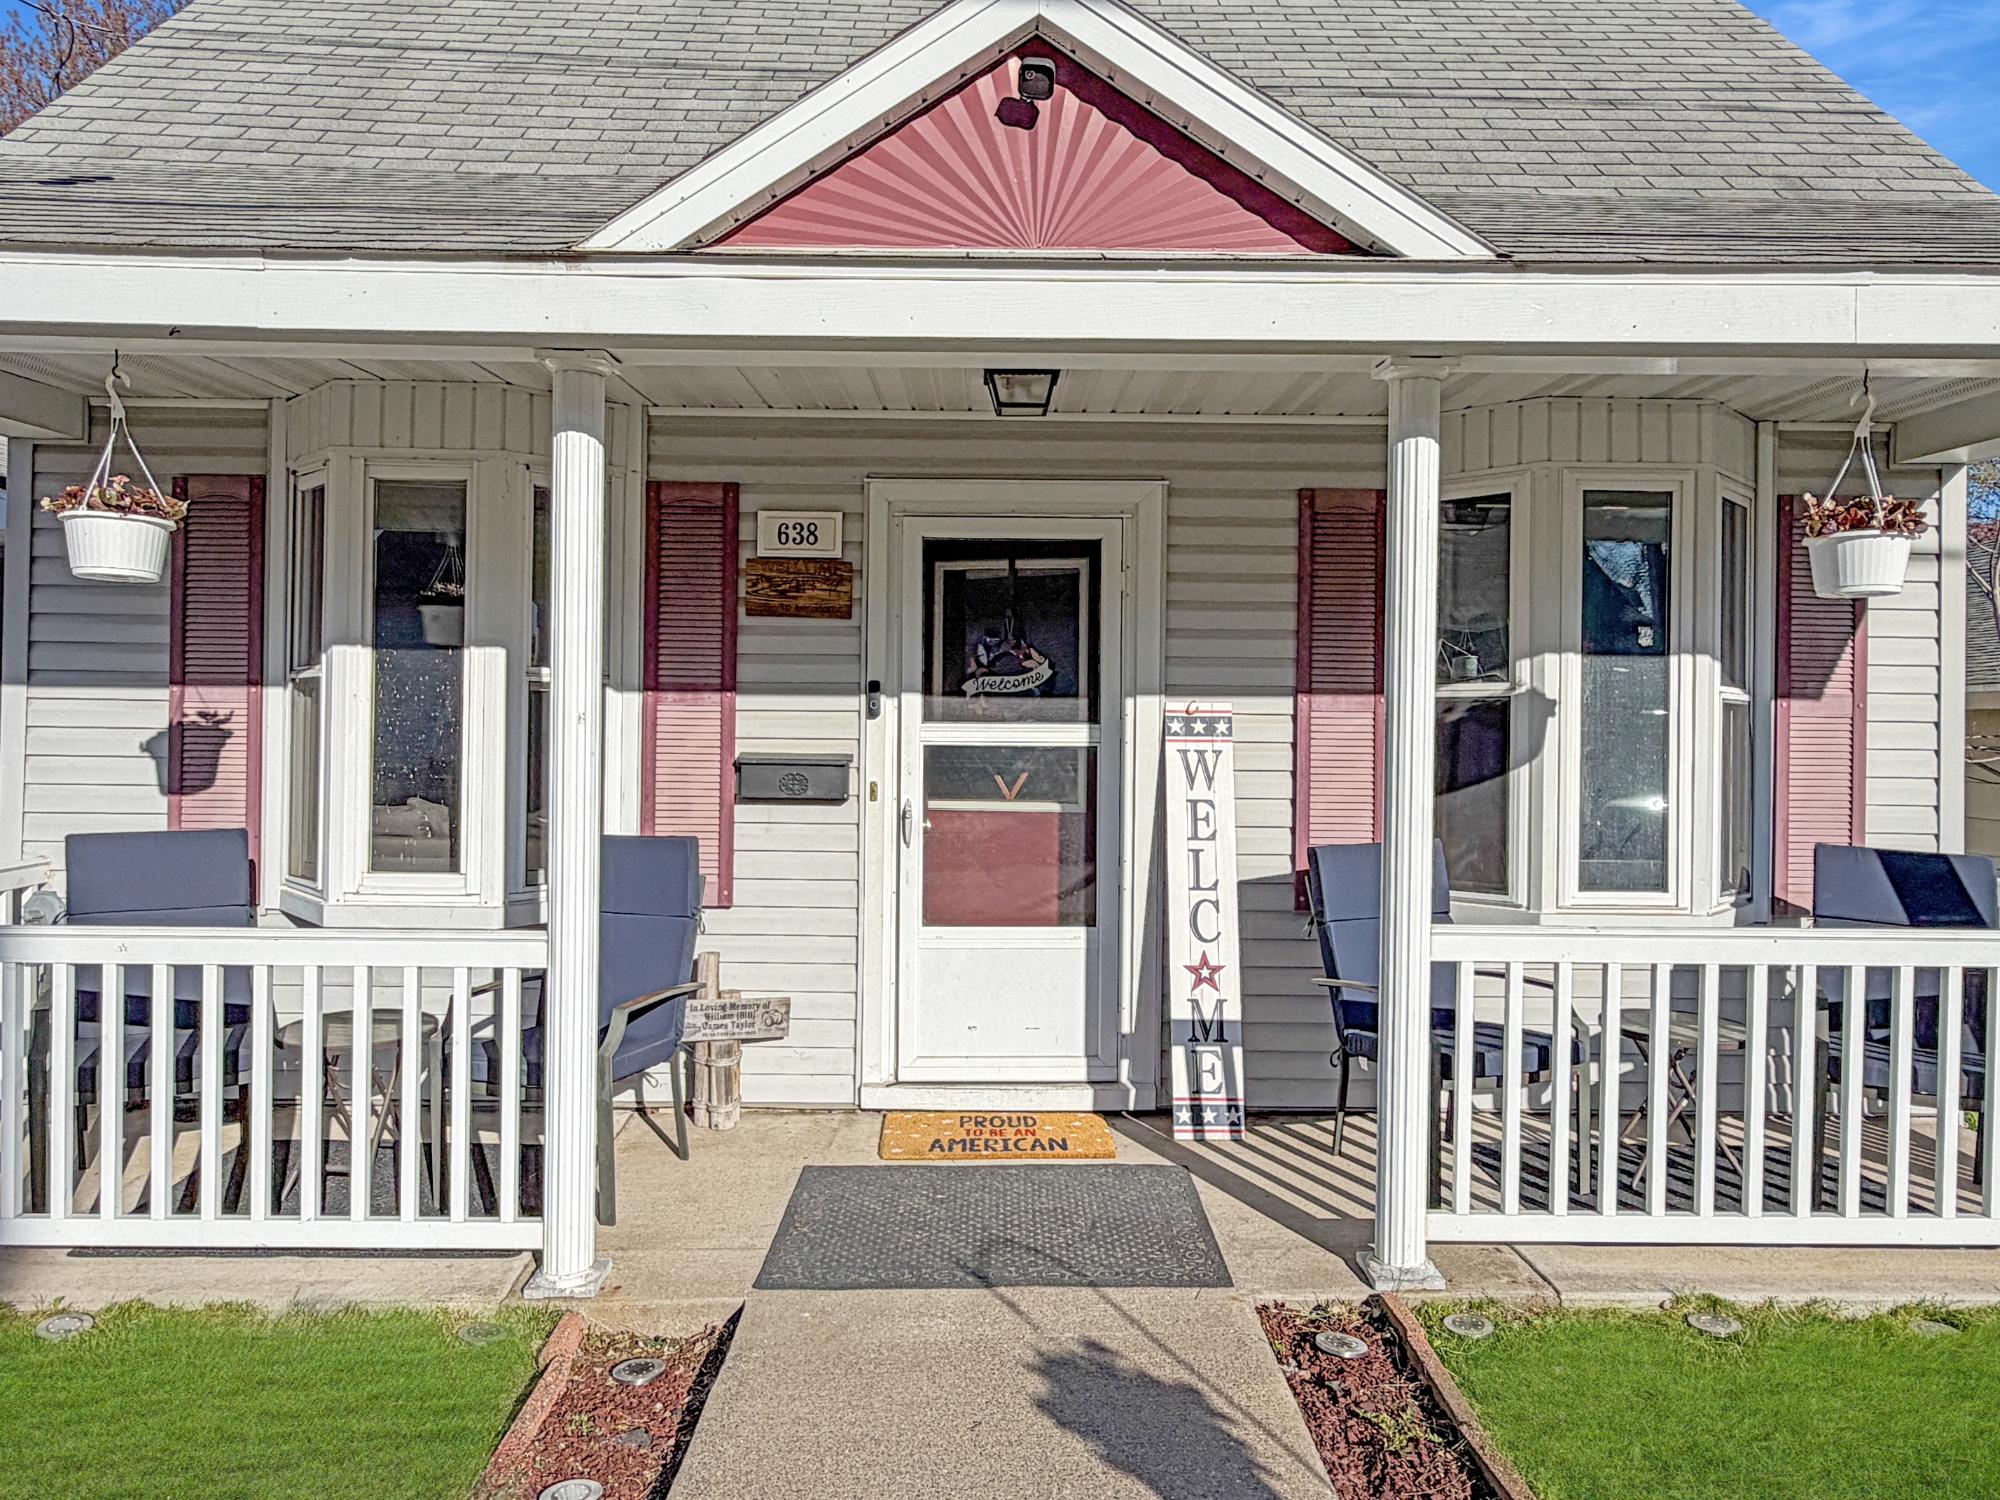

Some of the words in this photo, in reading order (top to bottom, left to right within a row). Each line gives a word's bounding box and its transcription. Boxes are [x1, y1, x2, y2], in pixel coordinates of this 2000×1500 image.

[777, 522, 819, 546] 638
[973, 671, 1044, 691] Welcome
[1177, 749, 1228, 1095] WELCME
[689, 1004, 698, 1012] In
[700, 1003, 727, 1013] Loving
[729, 1002, 760, 1012] Memory
[763, 1001, 771, 1010] of
[704, 1012, 734, 1021] William
[736, 1011, 756, 1021] (Bill)
[701, 1022, 728, 1031] James
[731, 1021, 756, 1031] Taylor
[959, 1115, 1037, 1128] PROUD
[964, 1128, 984, 1137] TO
[989, 1128, 1007, 1137] BE
[1011, 1128, 1037, 1137] AN
[928, 1137, 1069, 1152] AMERICAN
